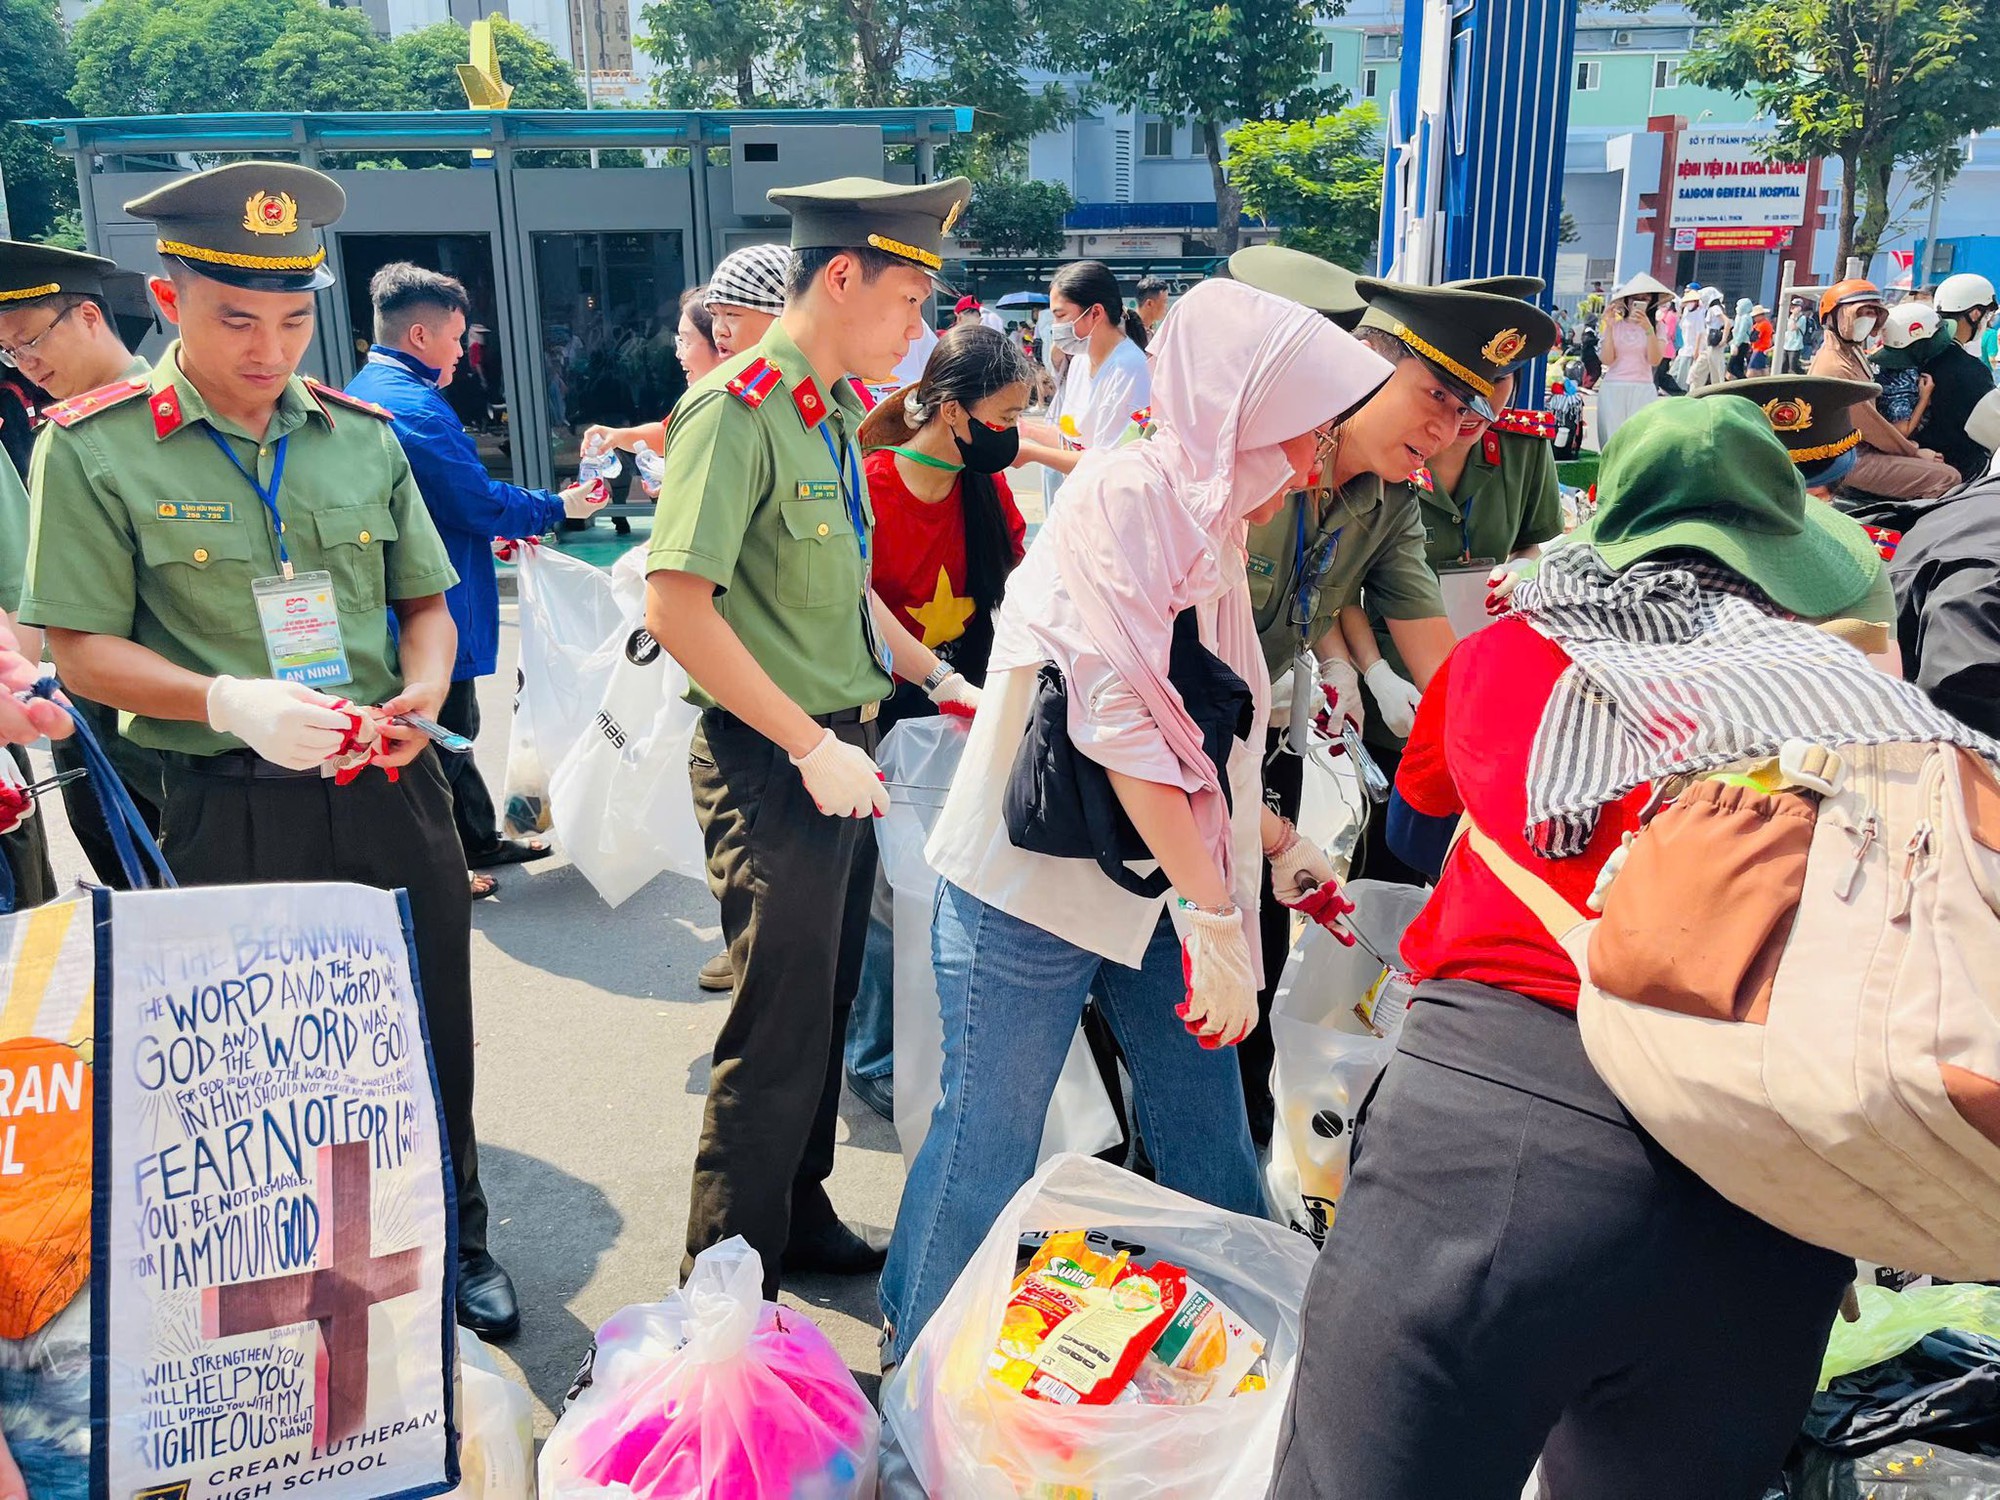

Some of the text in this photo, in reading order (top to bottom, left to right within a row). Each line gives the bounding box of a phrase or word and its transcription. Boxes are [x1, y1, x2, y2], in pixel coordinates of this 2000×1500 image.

[1740, 161, 1766, 175] KHOA
[1679, 186, 1800, 199] SAIGON GENERAL HOSPITAL
[286, 664, 341, 681] AN NINH
[231, 923, 372, 975] BEGINNING
[326, 959, 354, 979] THE
[165, 972, 273, 1033] WORD
[281, 965, 324, 1009] AND
[330, 968, 380, 1006] WORD
[138, 995, 165, 1026] THE
[133, 1004, 409, 1090] GOD AND THE WORD WAS GOD
[176, 1088, 199, 1110] FOR
[199, 1078, 224, 1097] GOD
[236, 1070, 273, 1089] LOVED
[275, 1061, 301, 1083] THE
[181, 1105, 209, 1139] IN
[211, 1088, 252, 1127] HIM
[253, 1080, 299, 1109] SHOULD
[299, 1082, 322, 1094] NOT
[134, 1117, 257, 1206] FEAR
[344, 1098, 392, 1169] FOR
[191, 1194, 214, 1230] BE
[219, 1186, 251, 1214] NOT
[130, 1253, 157, 1278] FOR
[159, 1243, 167, 1291] I
[173, 1226, 213, 1291] AM
[213, 1203, 276, 1283] YOUR
[1040, 1256, 1096, 1289] Swing
[141, 1386, 183, 1405] WILL
[185, 1366, 252, 1405] HELP
[142, 1360, 186, 1387] WILL
[190, 1344, 275, 1377] STRENGTHEN
[179, 1403, 224, 1421] UPHOLD
[226, 1400, 245, 1413] YOU
[247, 1393, 273, 1414] WITH
[277, 1378, 305, 1416] MY
[135, 1405, 314, 1471] RIGHTEOUS RIGHT HAND
[208, 1409, 438, 1486] CREAN LUTHERAN
[282, 1451, 388, 1491] SCHOOL
